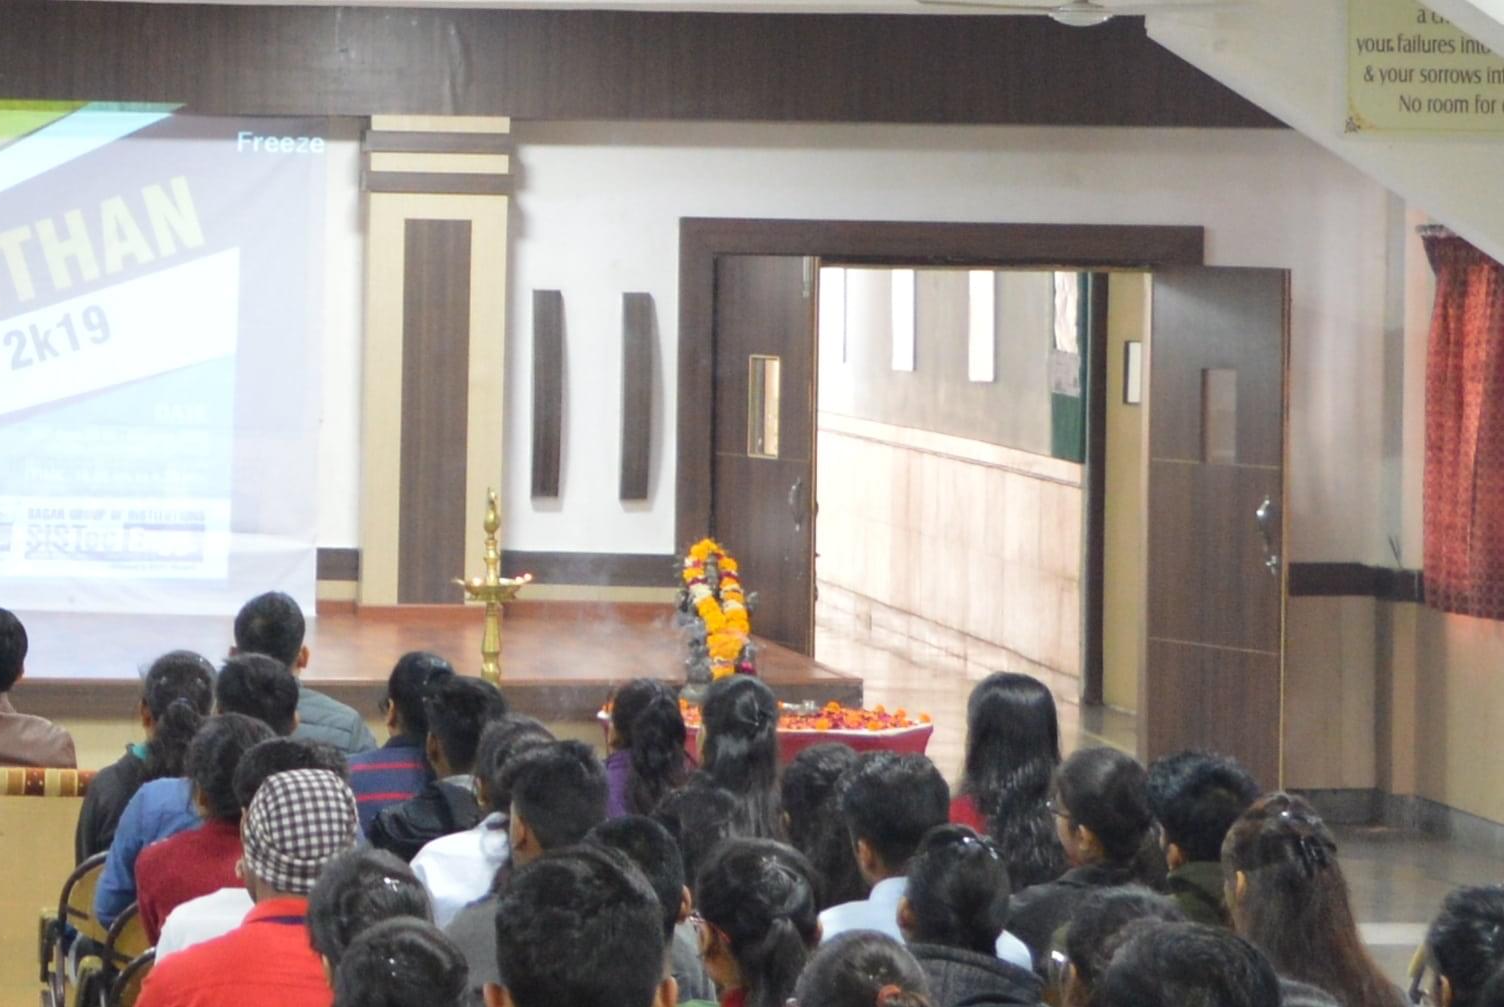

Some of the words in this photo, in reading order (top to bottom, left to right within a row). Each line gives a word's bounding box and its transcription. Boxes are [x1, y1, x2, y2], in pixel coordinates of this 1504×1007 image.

[1397, 32, 1456, 54] failures
[1363, 65, 1375, 83] &
[1379, 67, 1414, 86] your
[1420, 67, 1482, 84] sorrows
[1399, 94, 1423, 113] No
[1428, 97, 1469, 114] room
[1474, 94, 1495, 114] for
[237, 130, 326, 154] Freeze
[2, 305, 112, 372] 2k19
